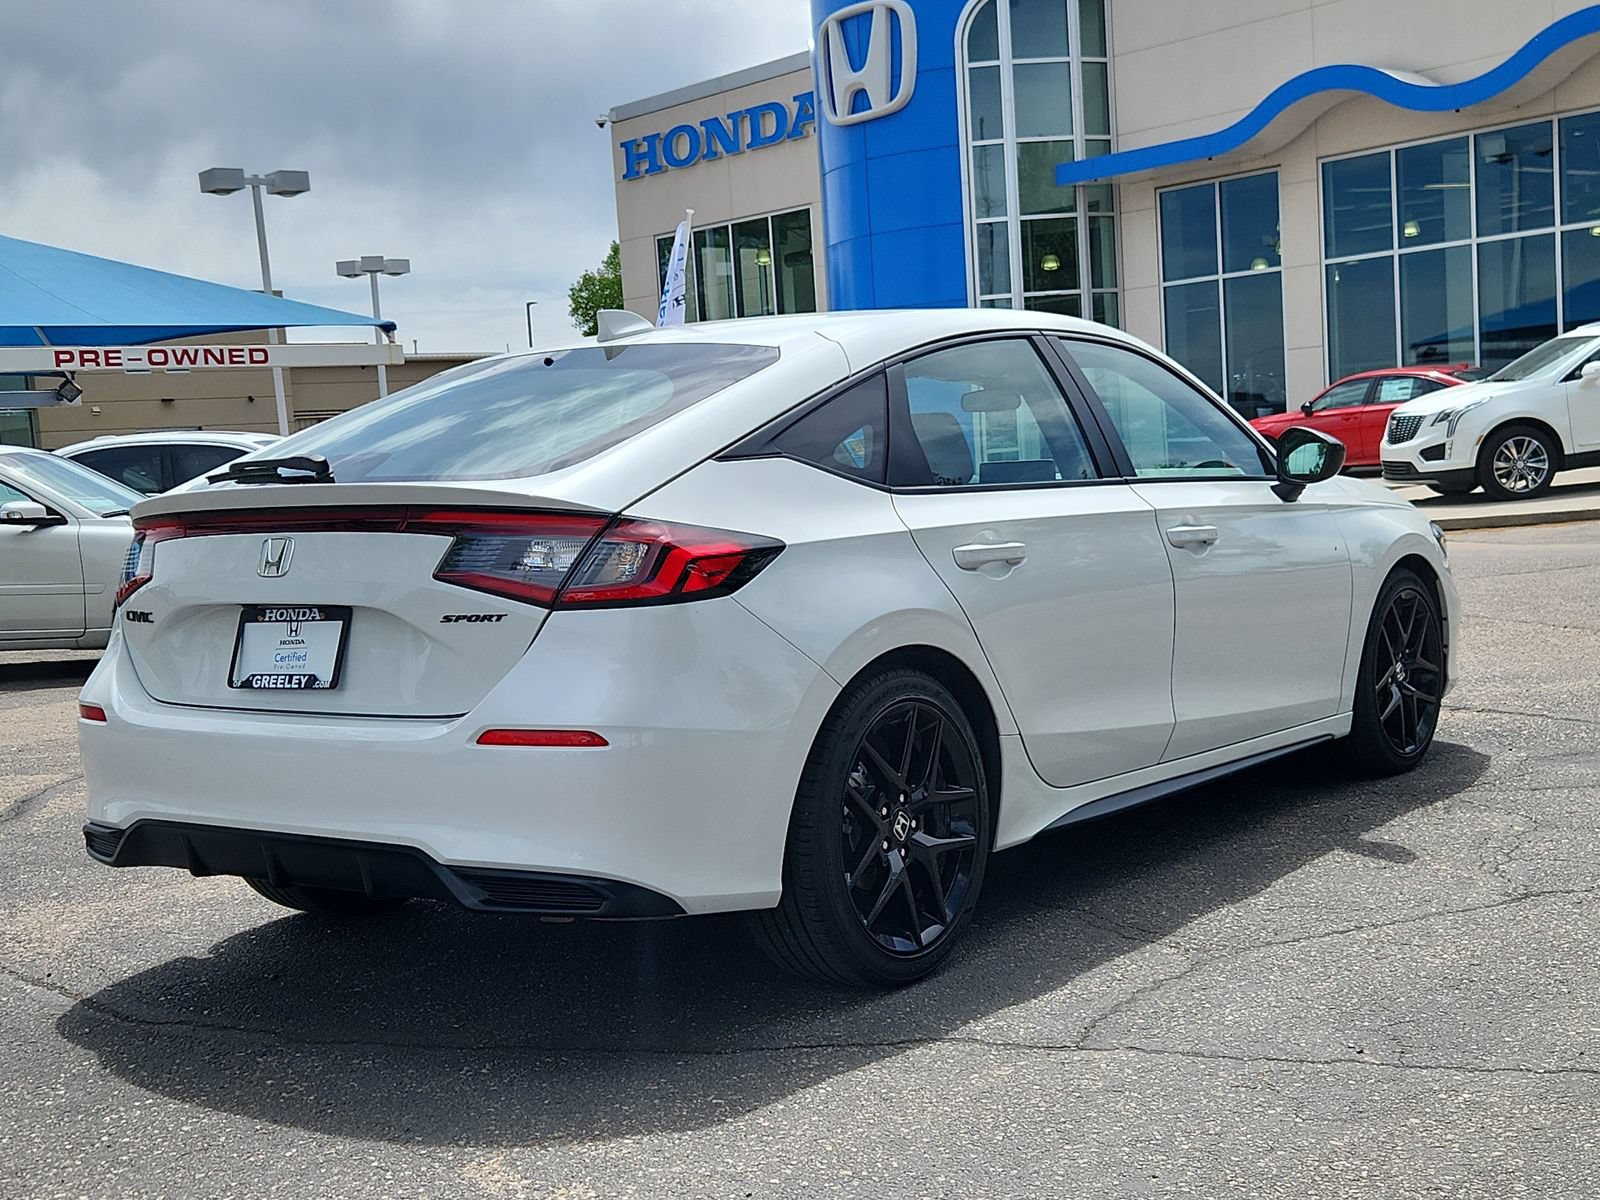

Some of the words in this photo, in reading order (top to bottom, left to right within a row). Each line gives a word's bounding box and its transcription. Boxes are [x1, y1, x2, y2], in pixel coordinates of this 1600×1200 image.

[619, 90, 816, 181] HONDA
[54, 348, 269, 367] PRE-OWNED
[263, 608, 321, 621] HONDA
[440, 614, 508, 623] SPORT
[274, 652, 307, 663] Certified
[252, 675, 309, 688] GREELEY
